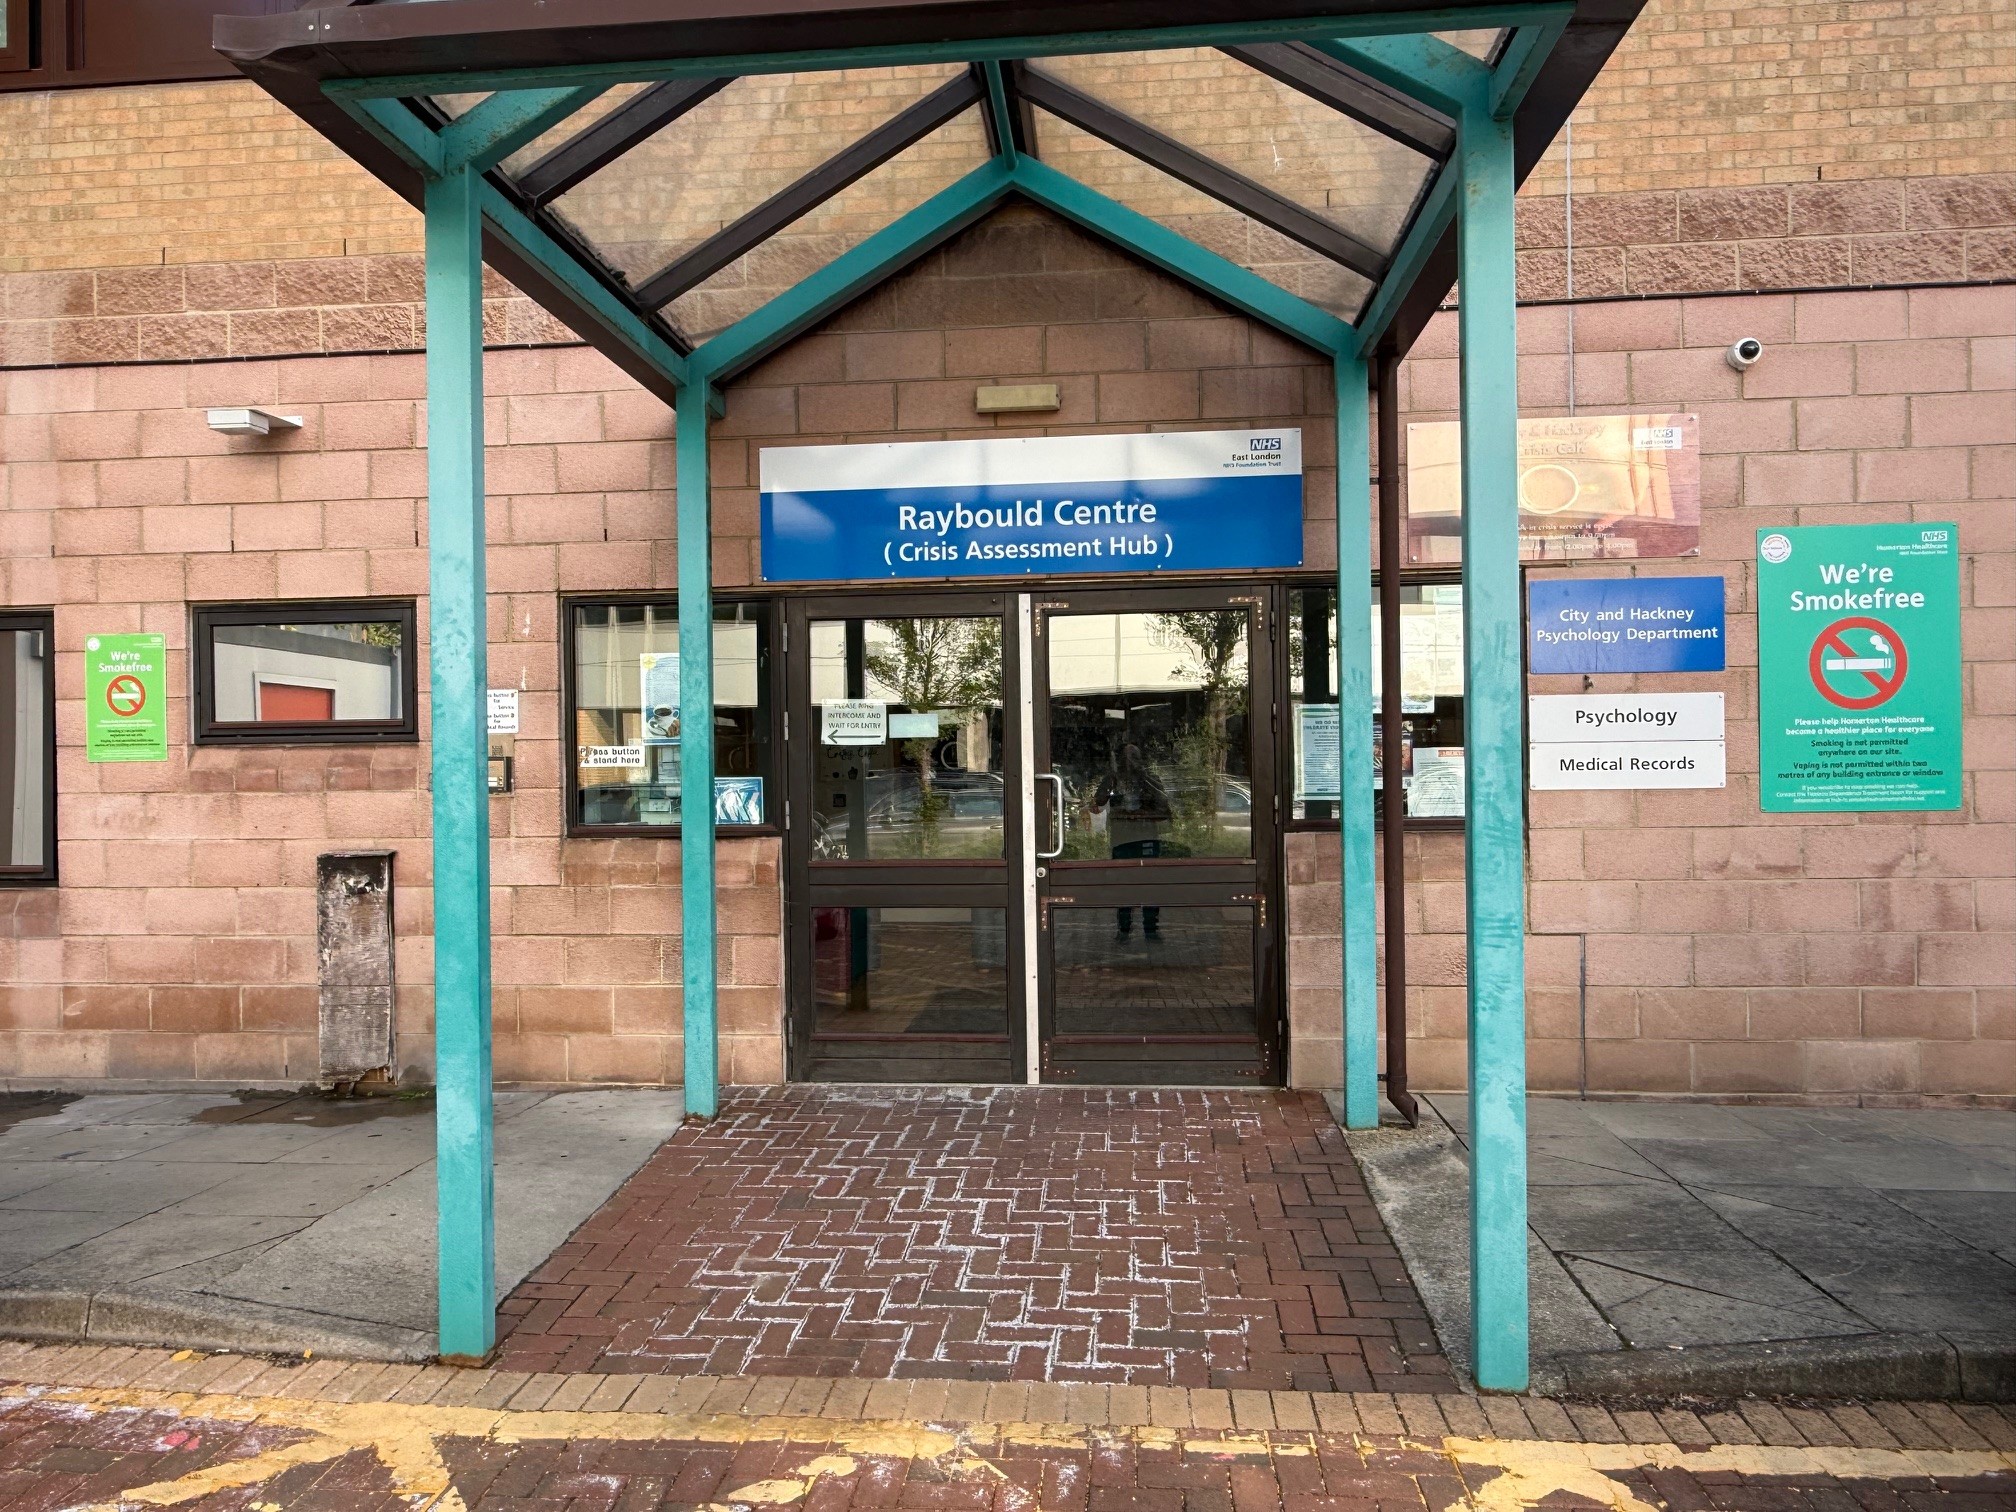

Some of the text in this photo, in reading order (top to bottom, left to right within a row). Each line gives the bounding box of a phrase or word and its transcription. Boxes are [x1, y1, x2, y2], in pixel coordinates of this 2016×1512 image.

[1252, 438, 1280, 450] NHS
[1232, 452, 1281, 461] East London
[900, 499, 1157, 536] Raybould Centre
[1923, 531, 1946, 541] NHS
[884, 534, 1173, 565] ( Crisis Assessment Hub )
[1912, 542, 1948, 550] Healthcare
[1819, 562, 1894, 585] We're
[1790, 587, 1925, 612] Smokefree
[1560, 606, 1694, 624] City and Hackney
[1536, 627, 1719, 644] Psychology Department
[110, 651, 141, 661] We're
[98, 662, 153, 673] Smokefree
[1575, 708, 1678, 727] Psychology
[1794, 716, 1925, 727] Please help Homerton Healthcare
[1785, 728, 1817, 736] become
[1824, 726, 1860, 735] healthier
[1861, 726, 1883, 735] place
[1884, 725, 1896, 733] for
[1898, 726, 1935, 735] everyone
[1811, 739, 1844, 748] Smoking
[1846, 739, 1853, 747] is
[1869, 738, 1909, 747] permitted
[612, 747, 640, 755] button
[1817, 748, 1856, 758] anywhere
[593, 756, 618, 764] stand
[621, 756, 640, 764] here
[1560, 756, 1695, 771] Medical Records
[1793, 761, 1820, 771] Vaping
[1845, 760, 1884, 770] permitted
[1885, 760, 1911, 768] within
[1832, 770, 1864, 780] building
[1865, 770, 1901, 778] entrance
[1912, 768, 1944, 777] window
